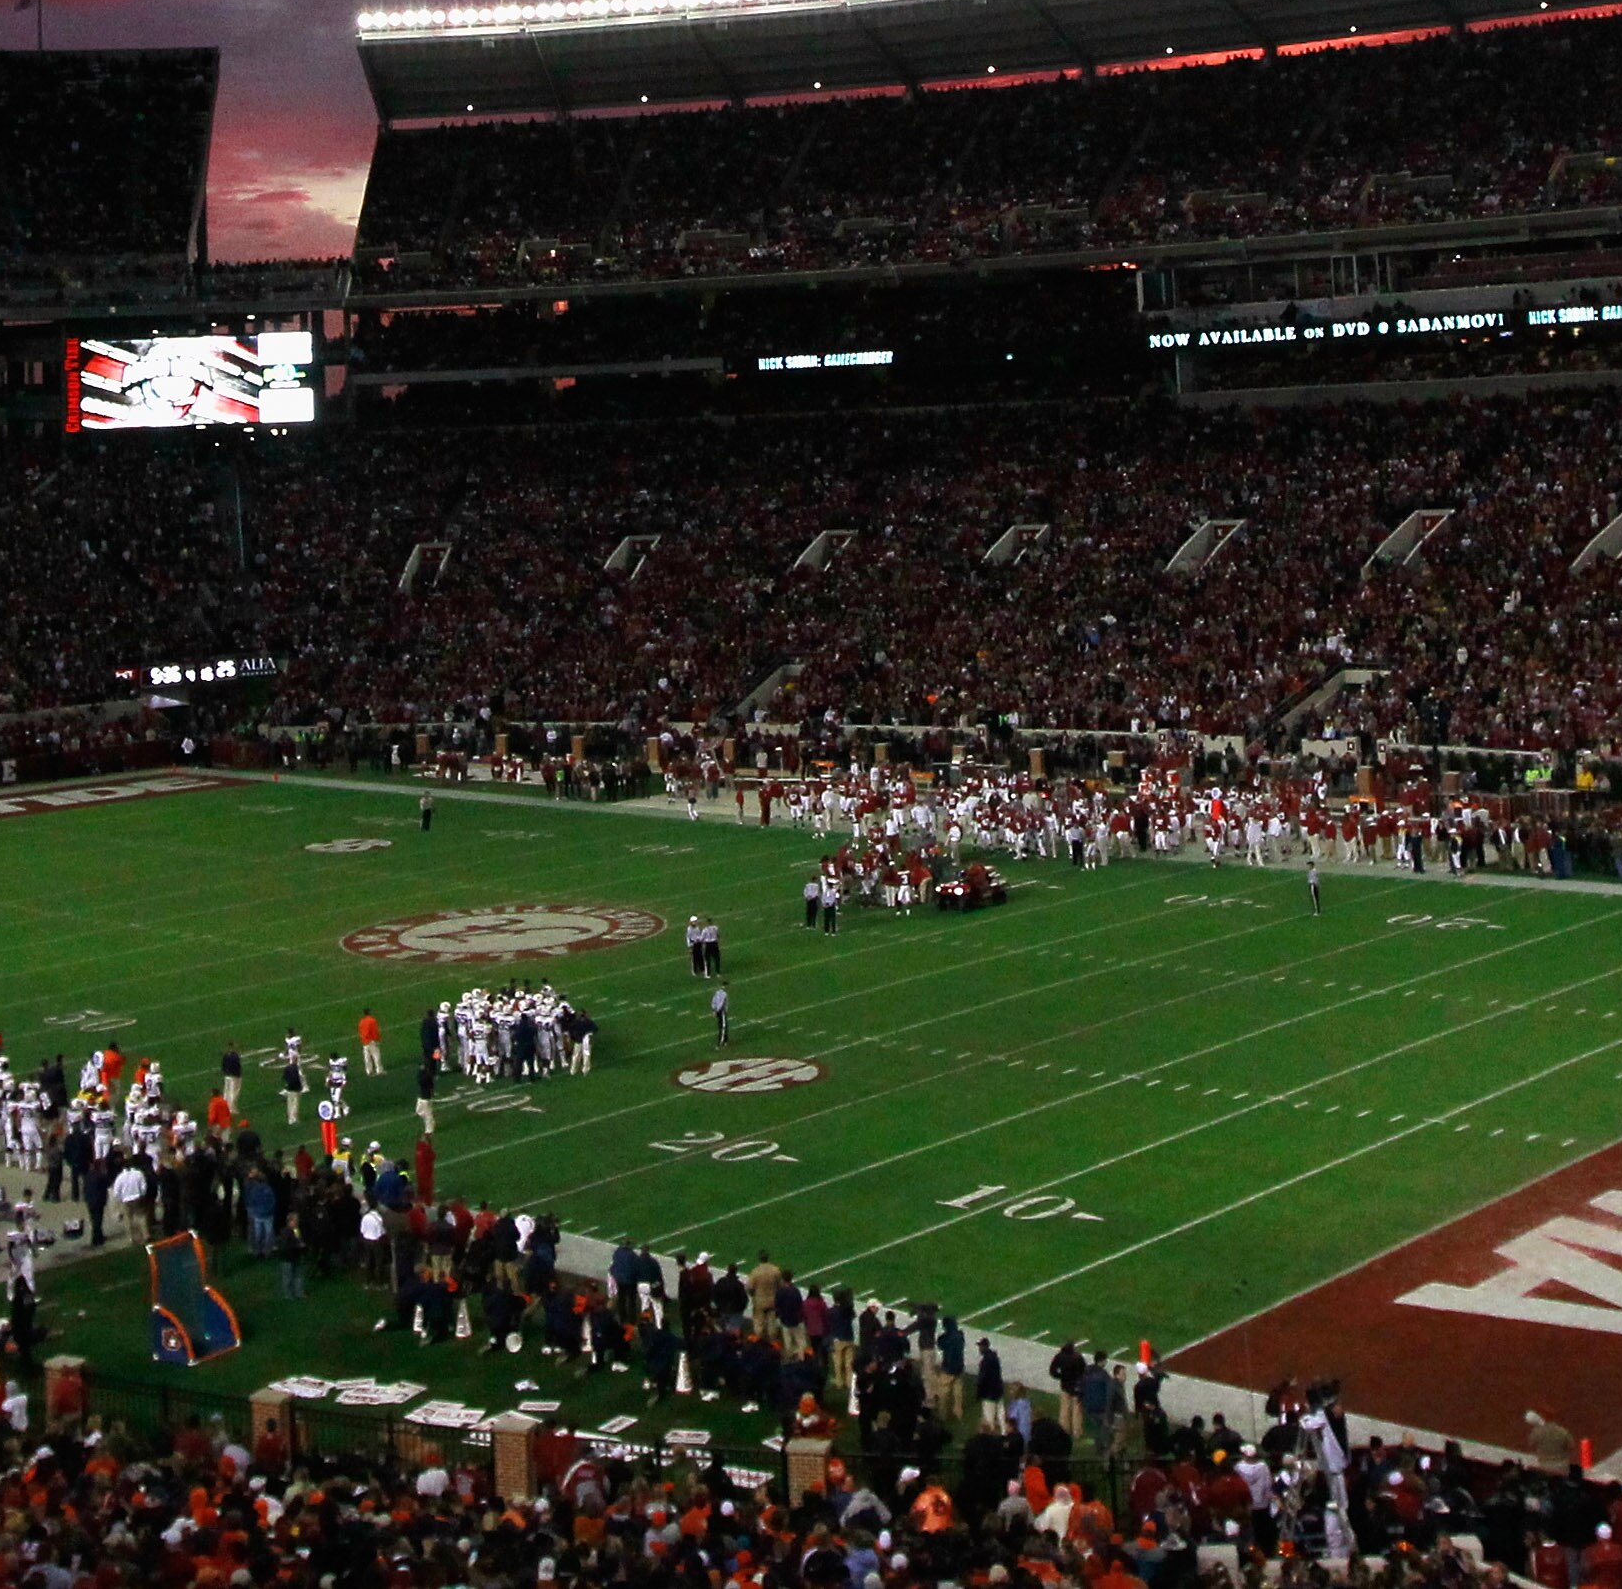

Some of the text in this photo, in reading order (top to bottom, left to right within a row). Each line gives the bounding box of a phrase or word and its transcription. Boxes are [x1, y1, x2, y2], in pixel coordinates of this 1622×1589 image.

[1528, 310, 1556, 326] NICK
[1148, 333, 1190, 349] NOW
[1198, 327, 1296, 346] AVAILABLE
[1332, 322, 1371, 338] DVD
[677, 1057, 820, 1092] SEC
[648, 1130, 781, 1163] 20
[935, 1183, 1078, 1222] 10
